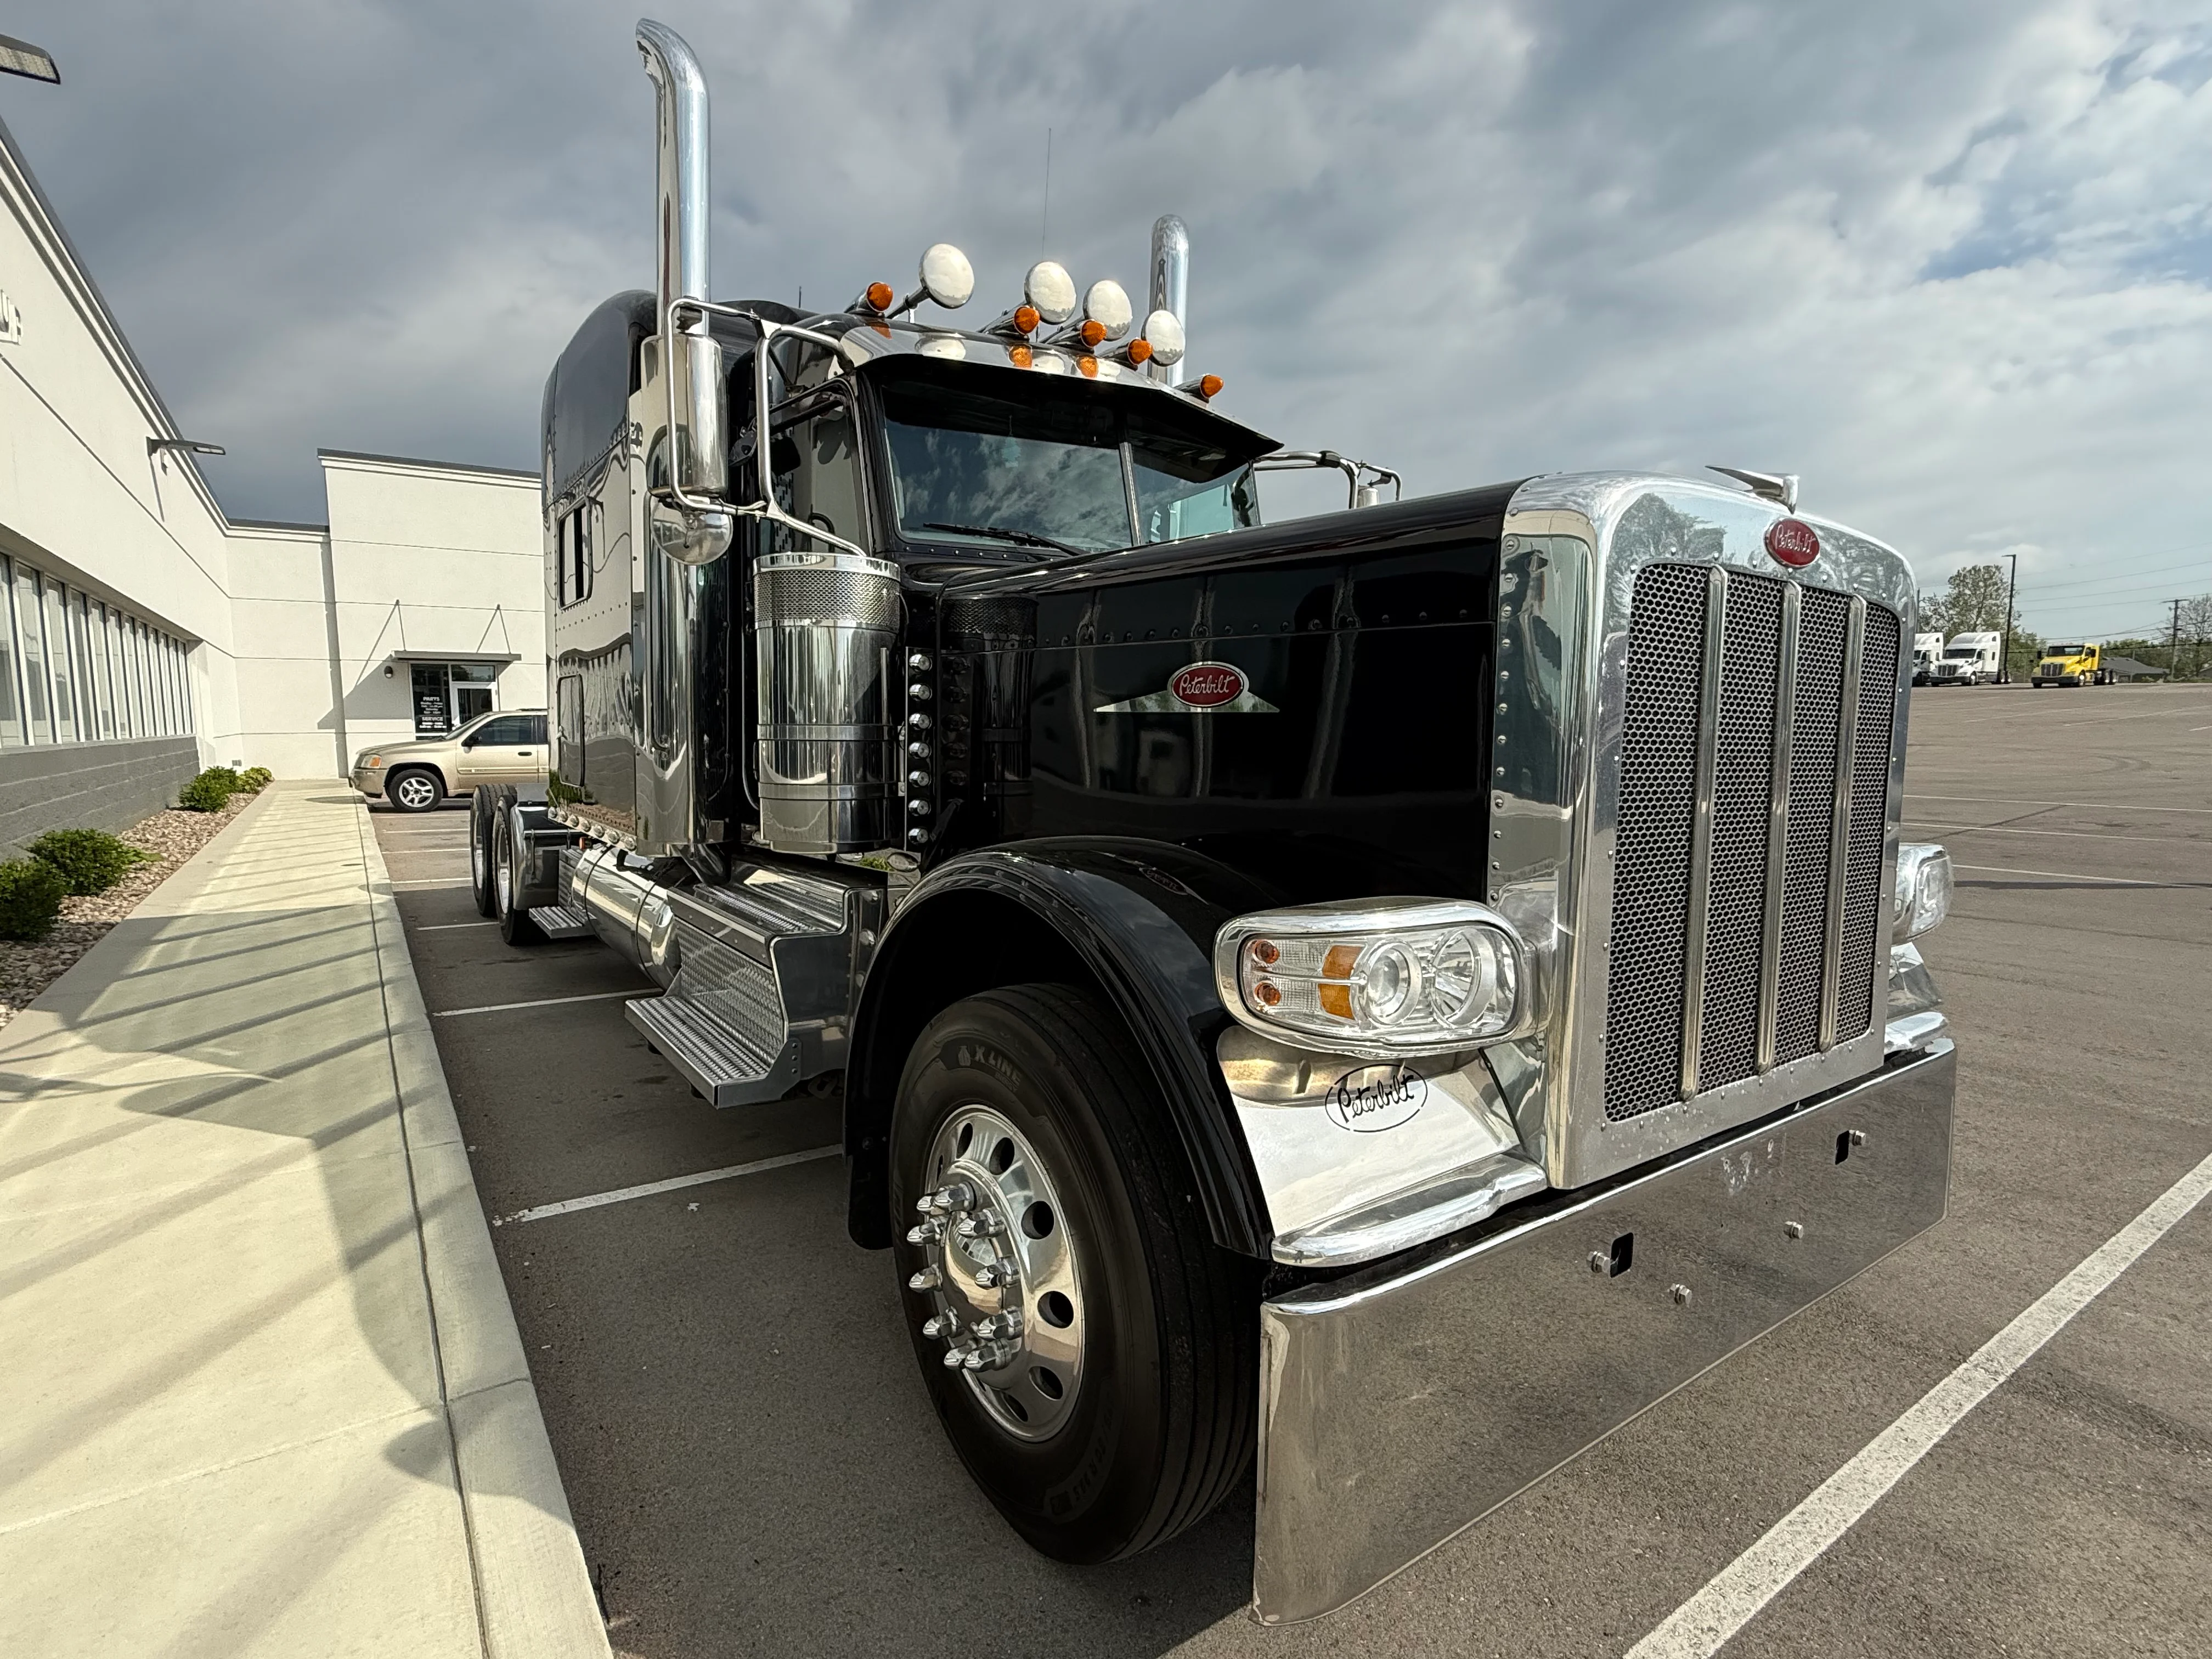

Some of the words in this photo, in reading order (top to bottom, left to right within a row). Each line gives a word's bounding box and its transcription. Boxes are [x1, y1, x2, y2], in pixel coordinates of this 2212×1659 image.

[1775, 524, 1816, 554] Peterbilt
[1179, 673, 1235, 697] Peterbilt
[988, 1049, 1022, 1086] LINE
[1338, 1074, 1414, 1124] Peterbilt
